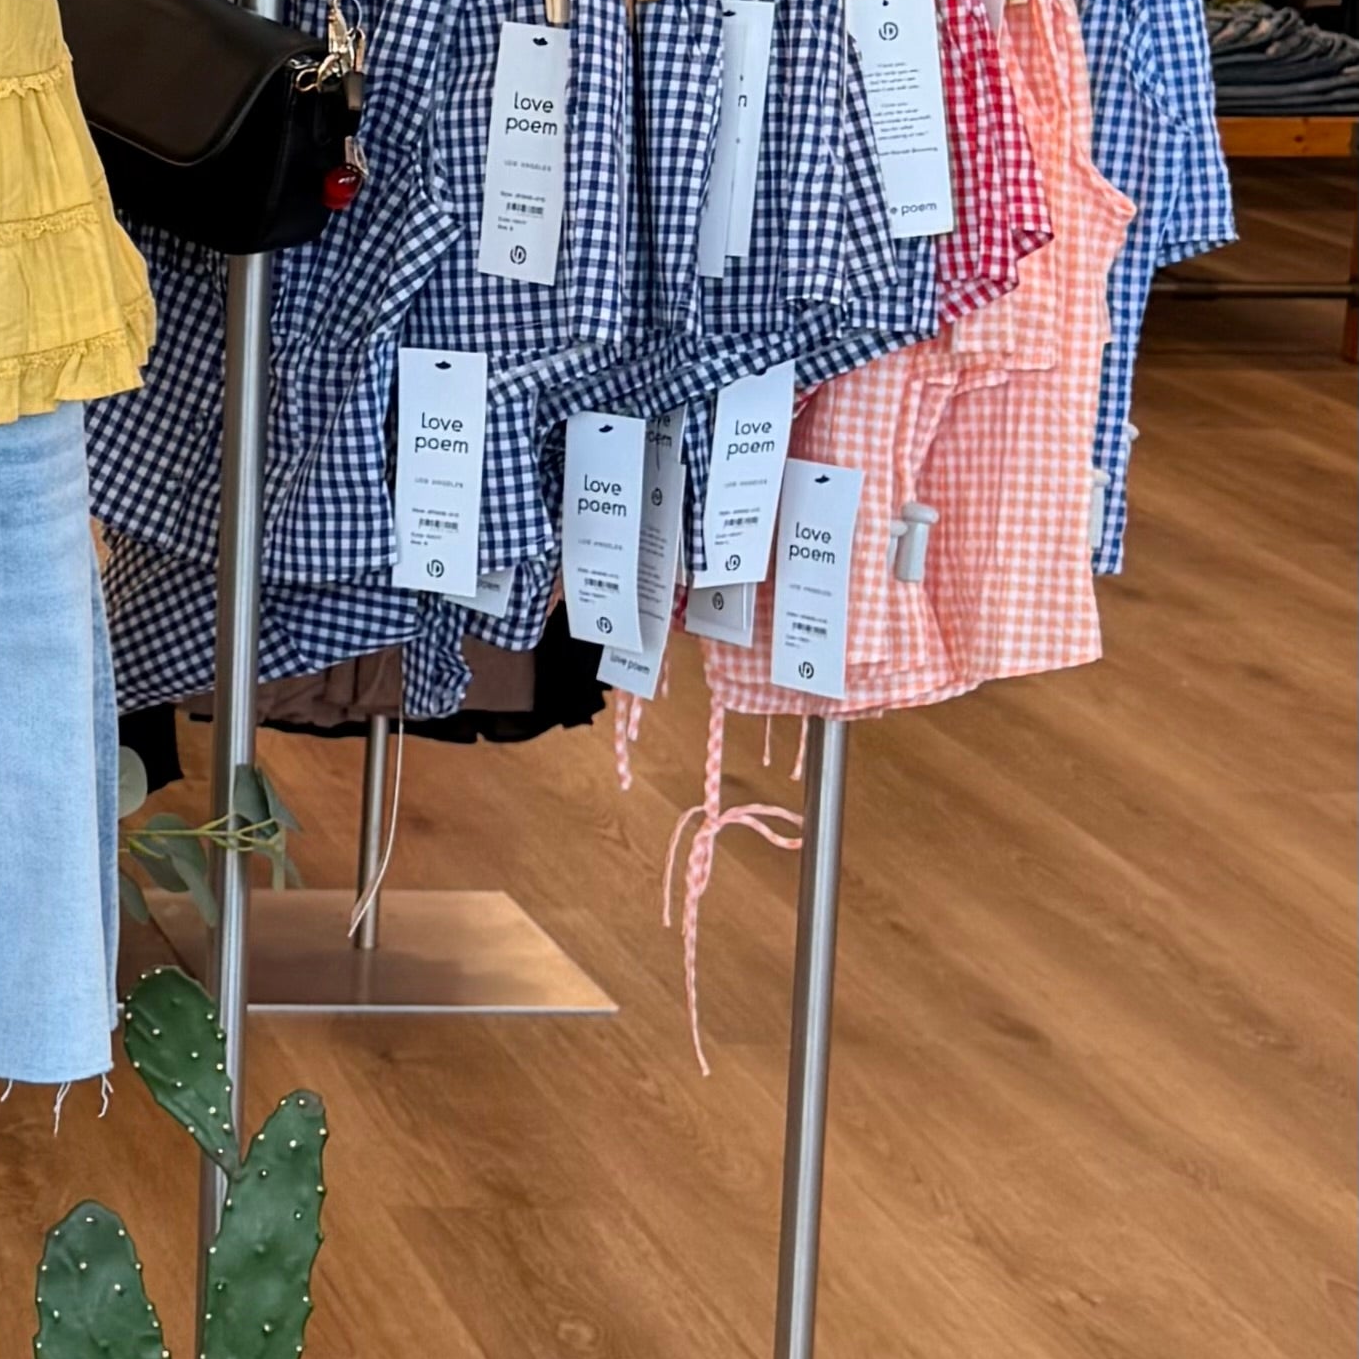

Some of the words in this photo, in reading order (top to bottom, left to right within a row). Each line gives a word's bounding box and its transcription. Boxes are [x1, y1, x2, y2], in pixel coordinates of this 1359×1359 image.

[513, 91, 554, 114] love
[505, 116, 558, 136] poem
[901, 202, 938, 217] poem
[421, 411, 464, 433] love
[734, 419, 773, 437] love
[414, 435, 469, 454] poem
[726, 439, 775, 461] poem
[583, 474, 623, 497] love
[576, 496, 628, 518] poem
[795, 521, 832, 544] love
[788, 543, 836, 565] poem
